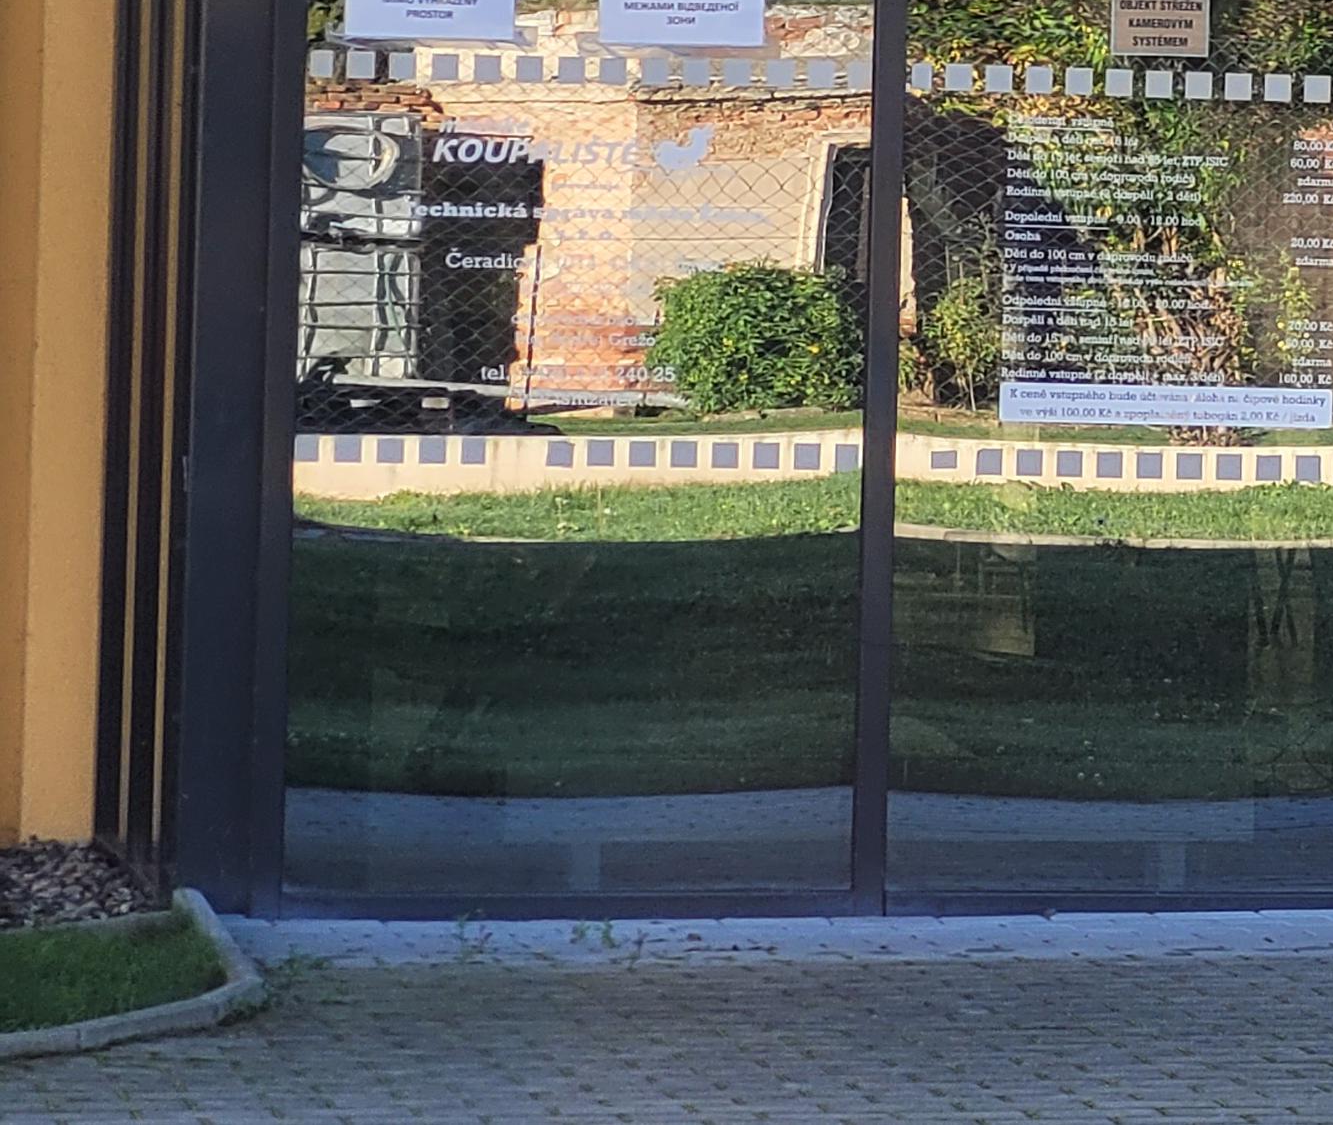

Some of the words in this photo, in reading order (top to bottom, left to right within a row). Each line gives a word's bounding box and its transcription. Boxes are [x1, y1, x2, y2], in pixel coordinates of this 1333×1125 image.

[624, 2, 674, 11] МЕЖАМИ
[1119, 0, 1157, 10] OBJEKT
[406, 9, 453, 19] PROSTOR
[666, 16, 696, 25] ЗОНИ
[1128, 16, 1194, 29] KAMEROVÝM
[1132, 35, 1189, 47] SYSTÉMEM
[432, 133, 638, 166] KOUPALIŠTĚ
[1293, 140, 1323, 152] 80,00
[1290, 158, 1320, 169] 60,00
[1029, 249, 1044, 260] do
[1048, 249, 1067, 261] 100
[1009, 388, 1018, 399] K
[1020, 389, 1046, 399] ceně
[1050, 390, 1106, 402] vstupného
[1109, 391, 1137, 401] bude
[1282, 395, 1326, 407] hodinky
[1019, 408, 1032, 416] ve
[1099, 407, 1112, 418] Kč
[1266, 411, 1279, 422] Kč
